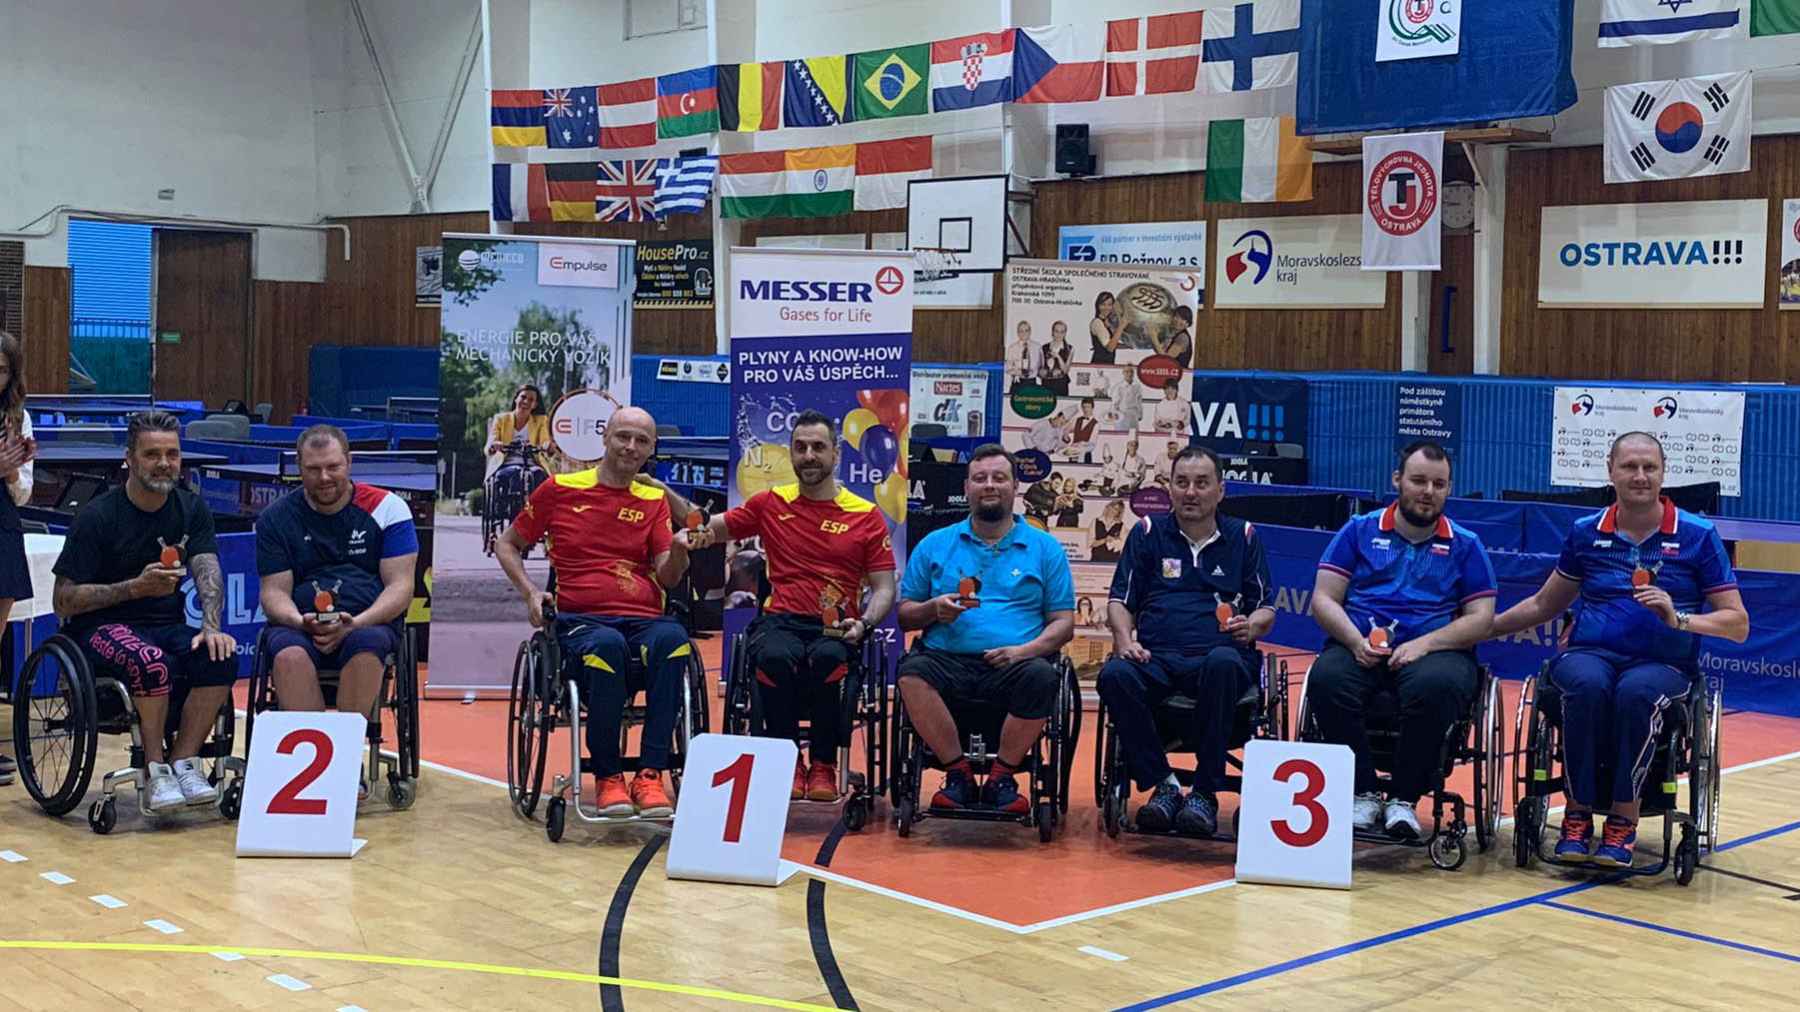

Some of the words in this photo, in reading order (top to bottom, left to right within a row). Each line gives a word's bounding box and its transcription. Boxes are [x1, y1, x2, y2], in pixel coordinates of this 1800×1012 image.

[1381, 218, 1422, 231] OSTRAVA
[550, 256, 608, 272] Empulse
[1041, 267, 1062, 275] ŠKOLA
[1276, 269, 1297, 285] kraj
[740, 280, 873, 303] MESSER
[780, 306, 820, 322] Gases
[824, 307, 844, 322] for
[849, 308, 872, 323] Life
[457, 330, 525, 346] ENERGIE
[530, 331, 562, 347] PRO
[566, 349, 611, 367] VOZÍK
[739, 351, 791, 366] PLYNY
[793, 350, 806, 364] A
[808, 347, 903, 364] KNOW-HOW
[744, 369, 778, 384] PRO
[782, 364, 816, 382] VÁŠ
[1400, 386, 1415, 395] Pod
[1416, 387, 1446, 396] záštitou
[1422, 428, 1452, 438] Ostravy
[850, 463, 883, 484] He
[617, 508, 644, 524] ESP
[820, 519, 849, 535] ESP
[266, 728, 334, 815] 2
[711, 753, 755, 843] 1
[1271, 759, 1329, 848] 3
